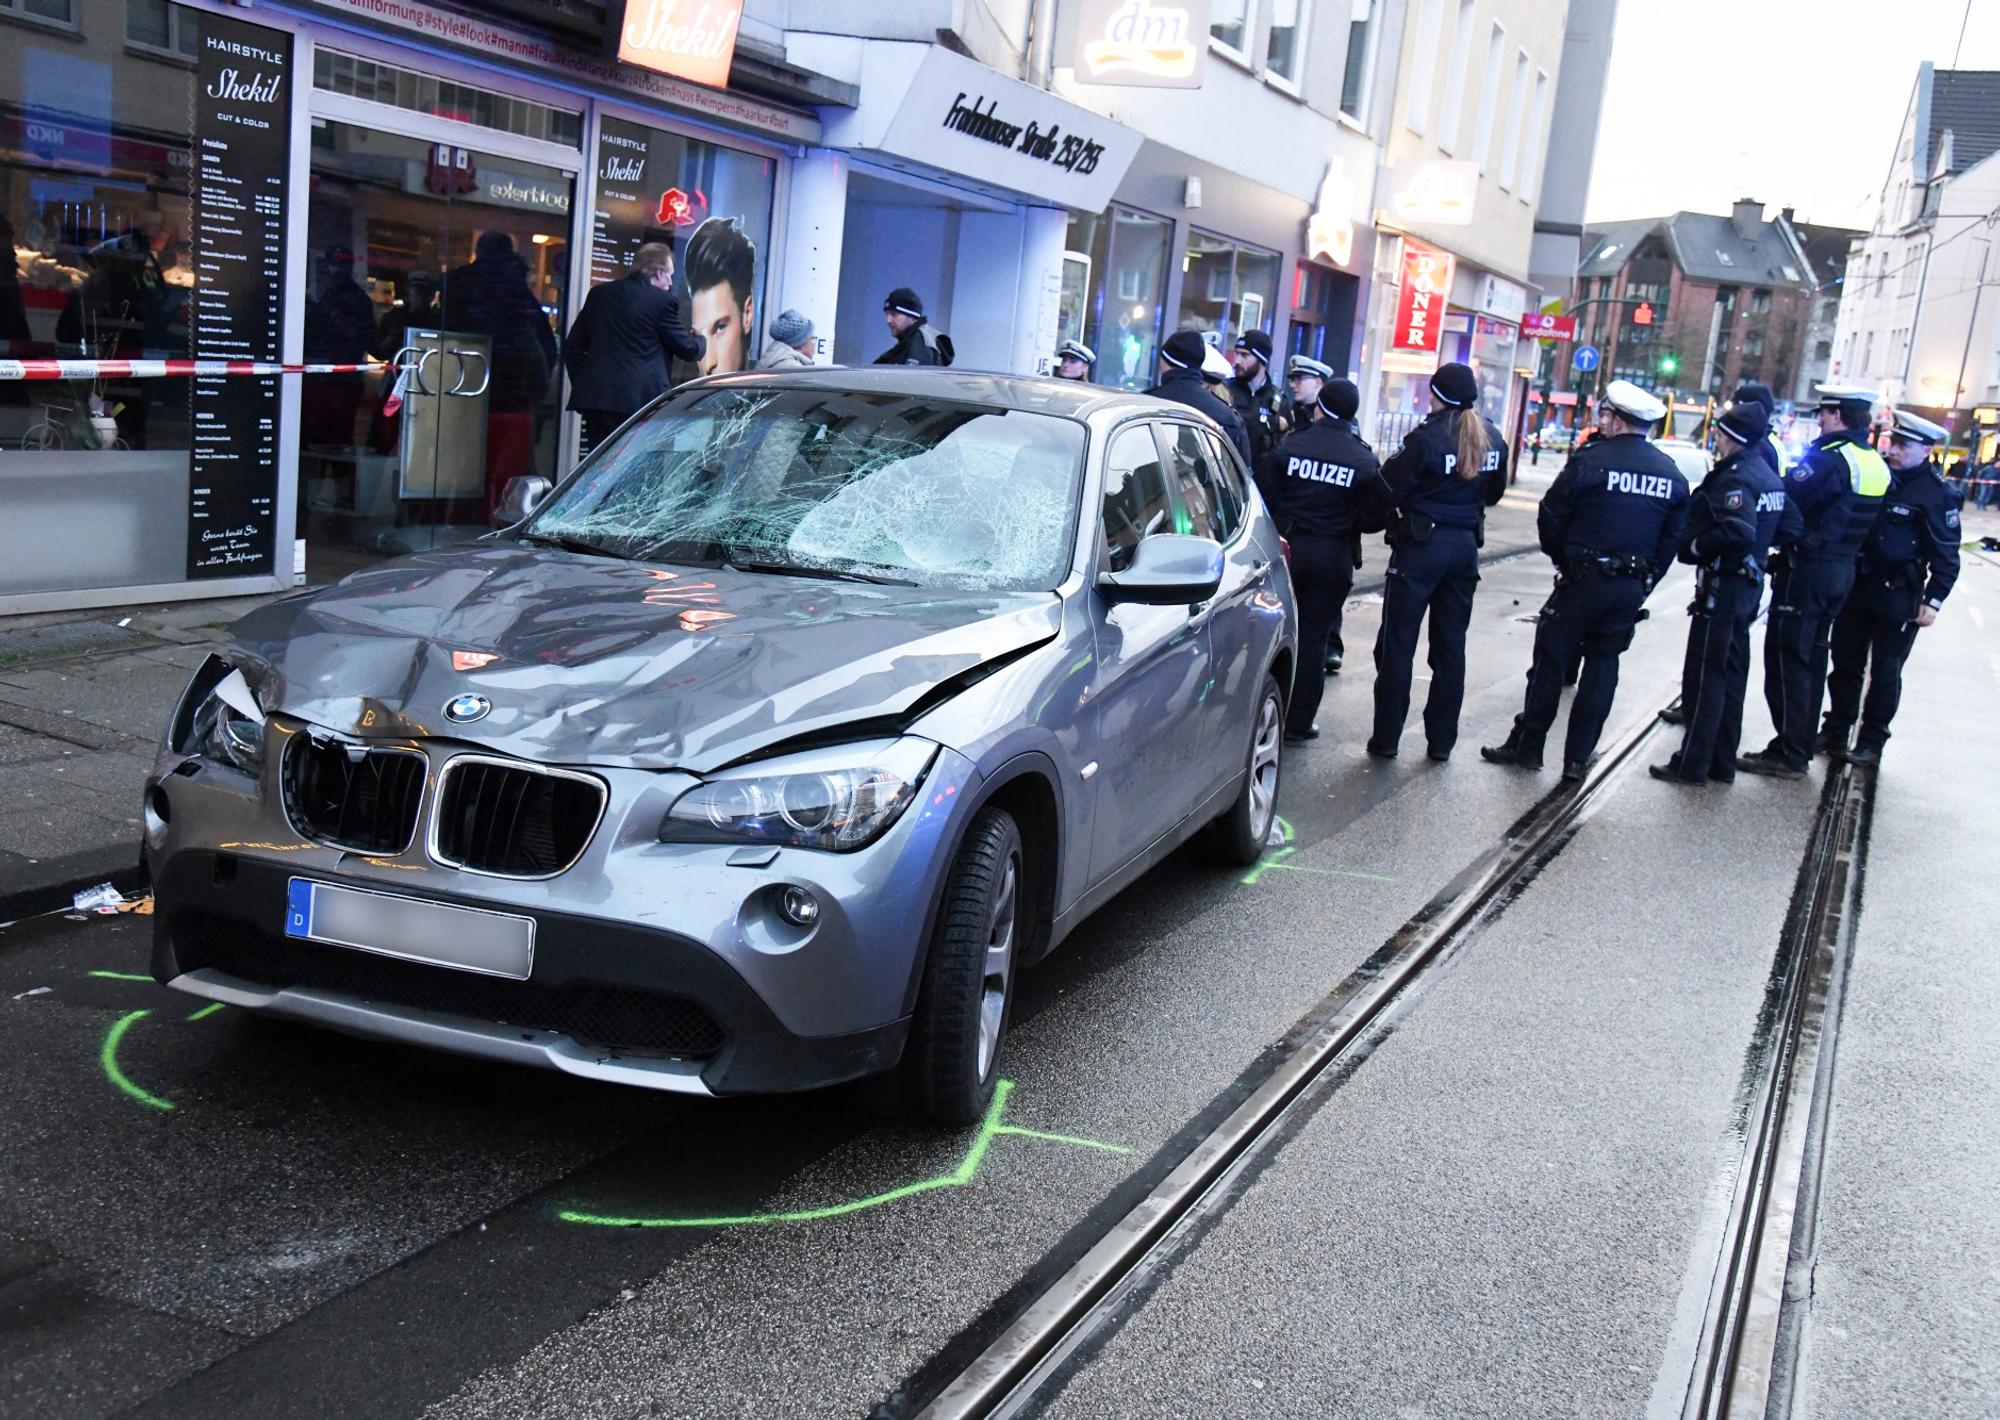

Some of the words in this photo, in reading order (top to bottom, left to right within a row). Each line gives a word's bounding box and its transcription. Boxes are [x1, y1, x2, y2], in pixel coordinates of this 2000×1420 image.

[626, 0, 737, 60] Shekil
[1111, 0, 1181, 43] dm
[207, 37, 283, 64] HAIRSTYLE
[207, 68, 281, 103] Shekil
[217, 113, 234, 122] CUT
[243, 118, 270, 129] COLOR
[601, 133, 647, 152] HAIRSTYLE
[600, 156, 645, 181] Shekil
[620, 193, 636, 201] COLOR
[1523, 326, 1571, 339] vodafone
[1287, 457, 1355, 488] POLIZEI
[1606, 471, 1673, 499] POLIZEI
[294, 914, 304, 927] D
